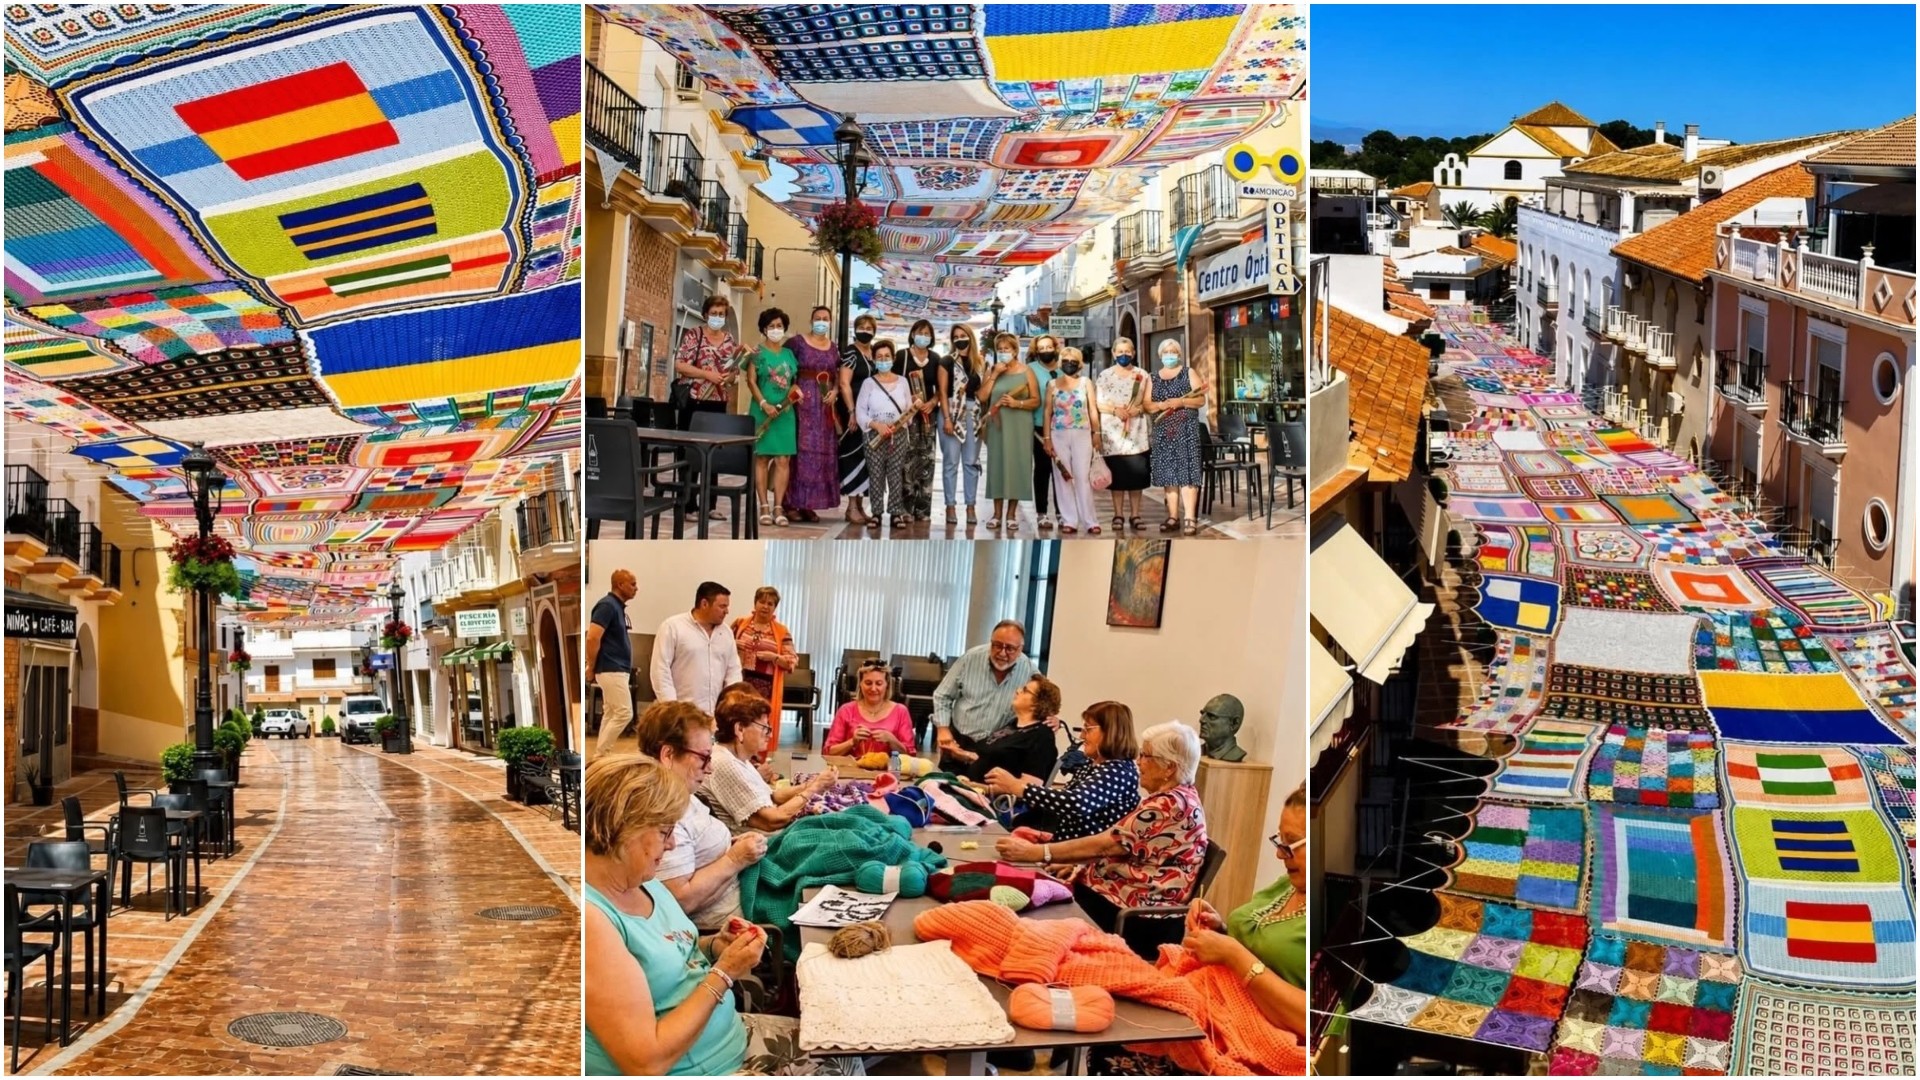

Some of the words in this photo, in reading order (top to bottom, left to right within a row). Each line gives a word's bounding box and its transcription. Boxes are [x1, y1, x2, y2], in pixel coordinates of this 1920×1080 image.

[1273, 202, 1288, 291] OPTICA
[1198, 264, 1238, 294] Centro
[40, 615, 56, 633] CAFÉ
[61, 619, 74, 633] BAR
